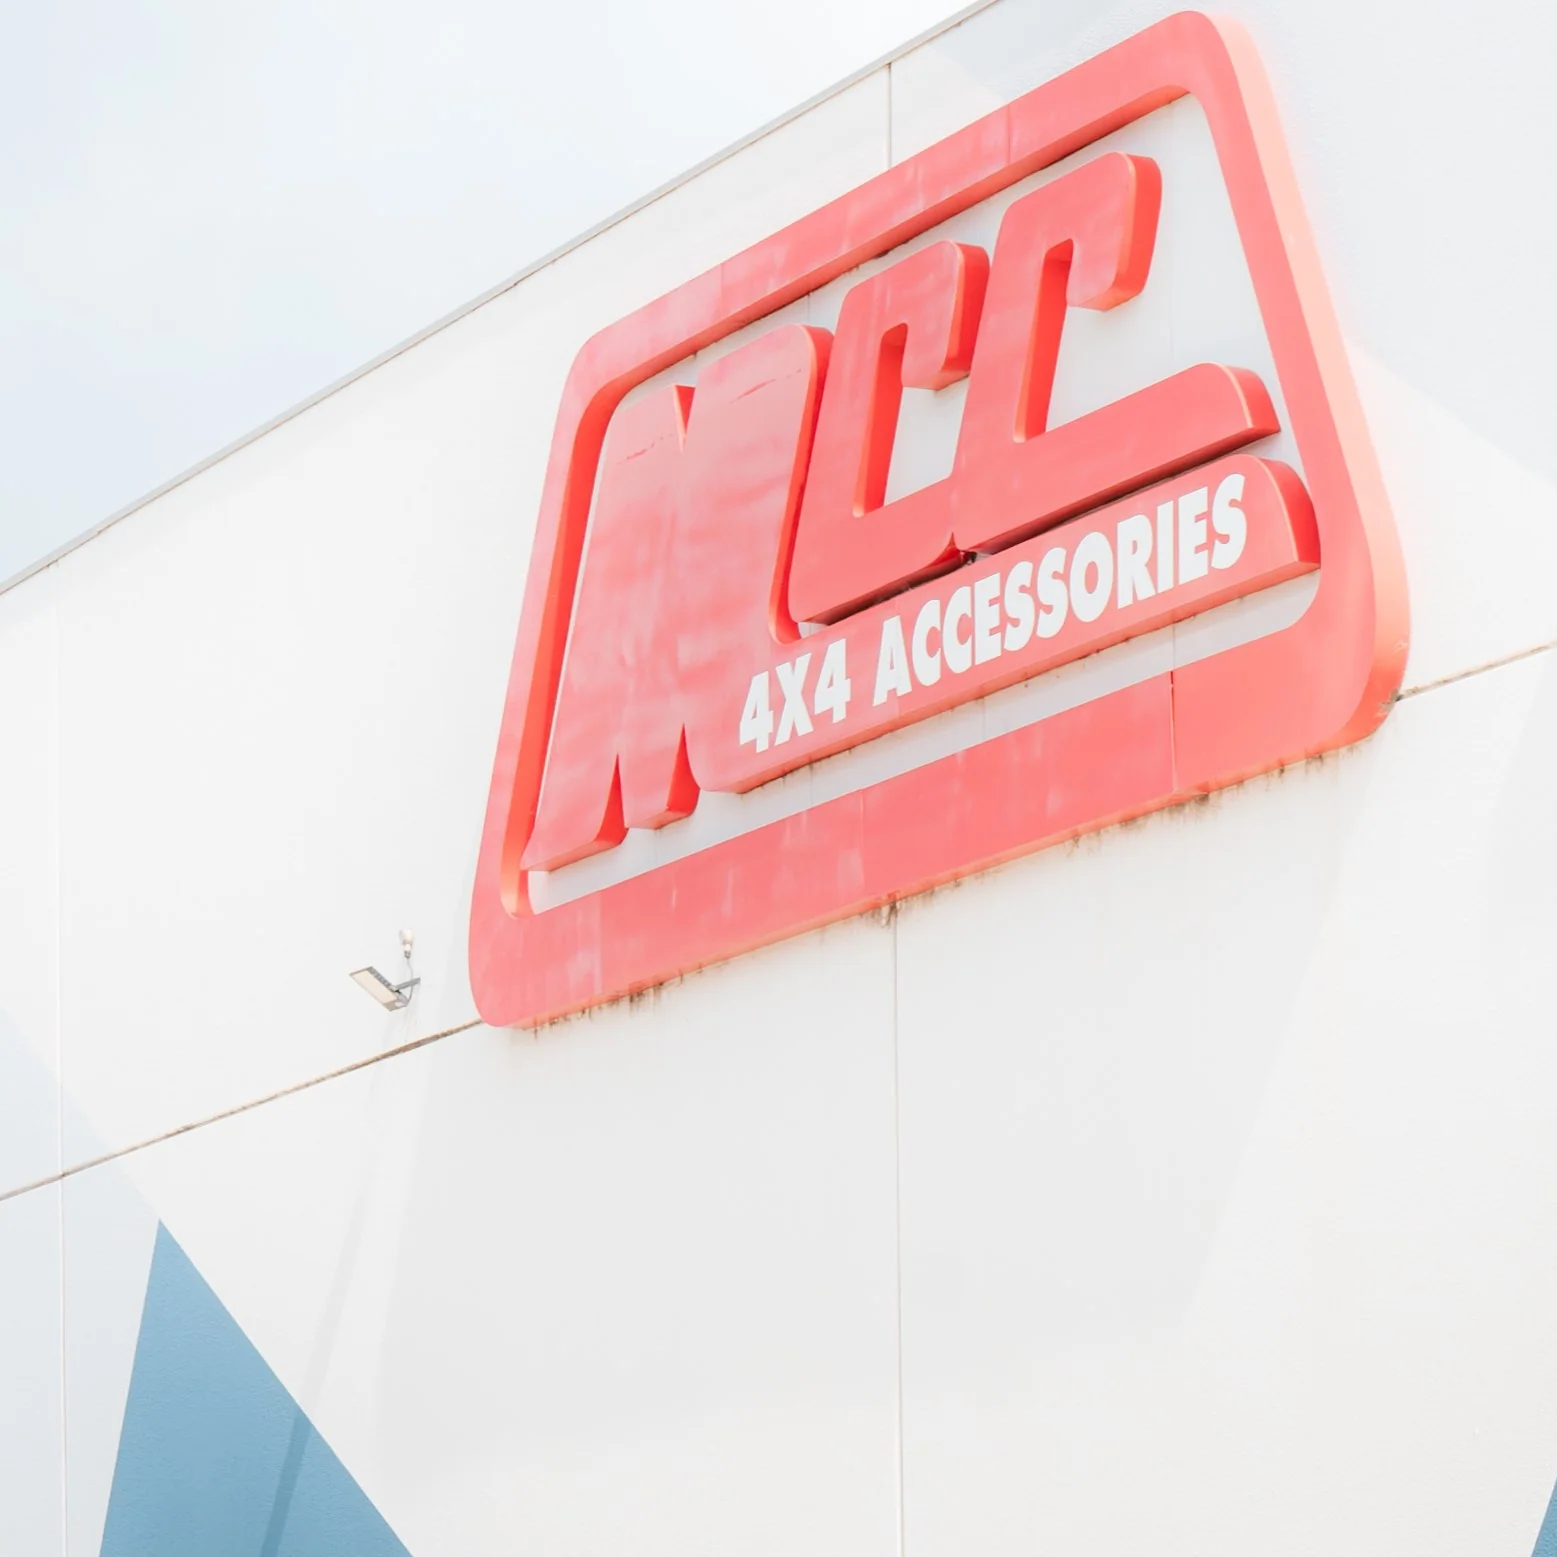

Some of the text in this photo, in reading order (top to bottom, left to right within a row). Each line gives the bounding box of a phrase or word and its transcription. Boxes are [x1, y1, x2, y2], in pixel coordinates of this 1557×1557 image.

[522, 151, 1281, 872] MCC
[738, 473, 1248, 754] 4X4 ACCESSORIES
